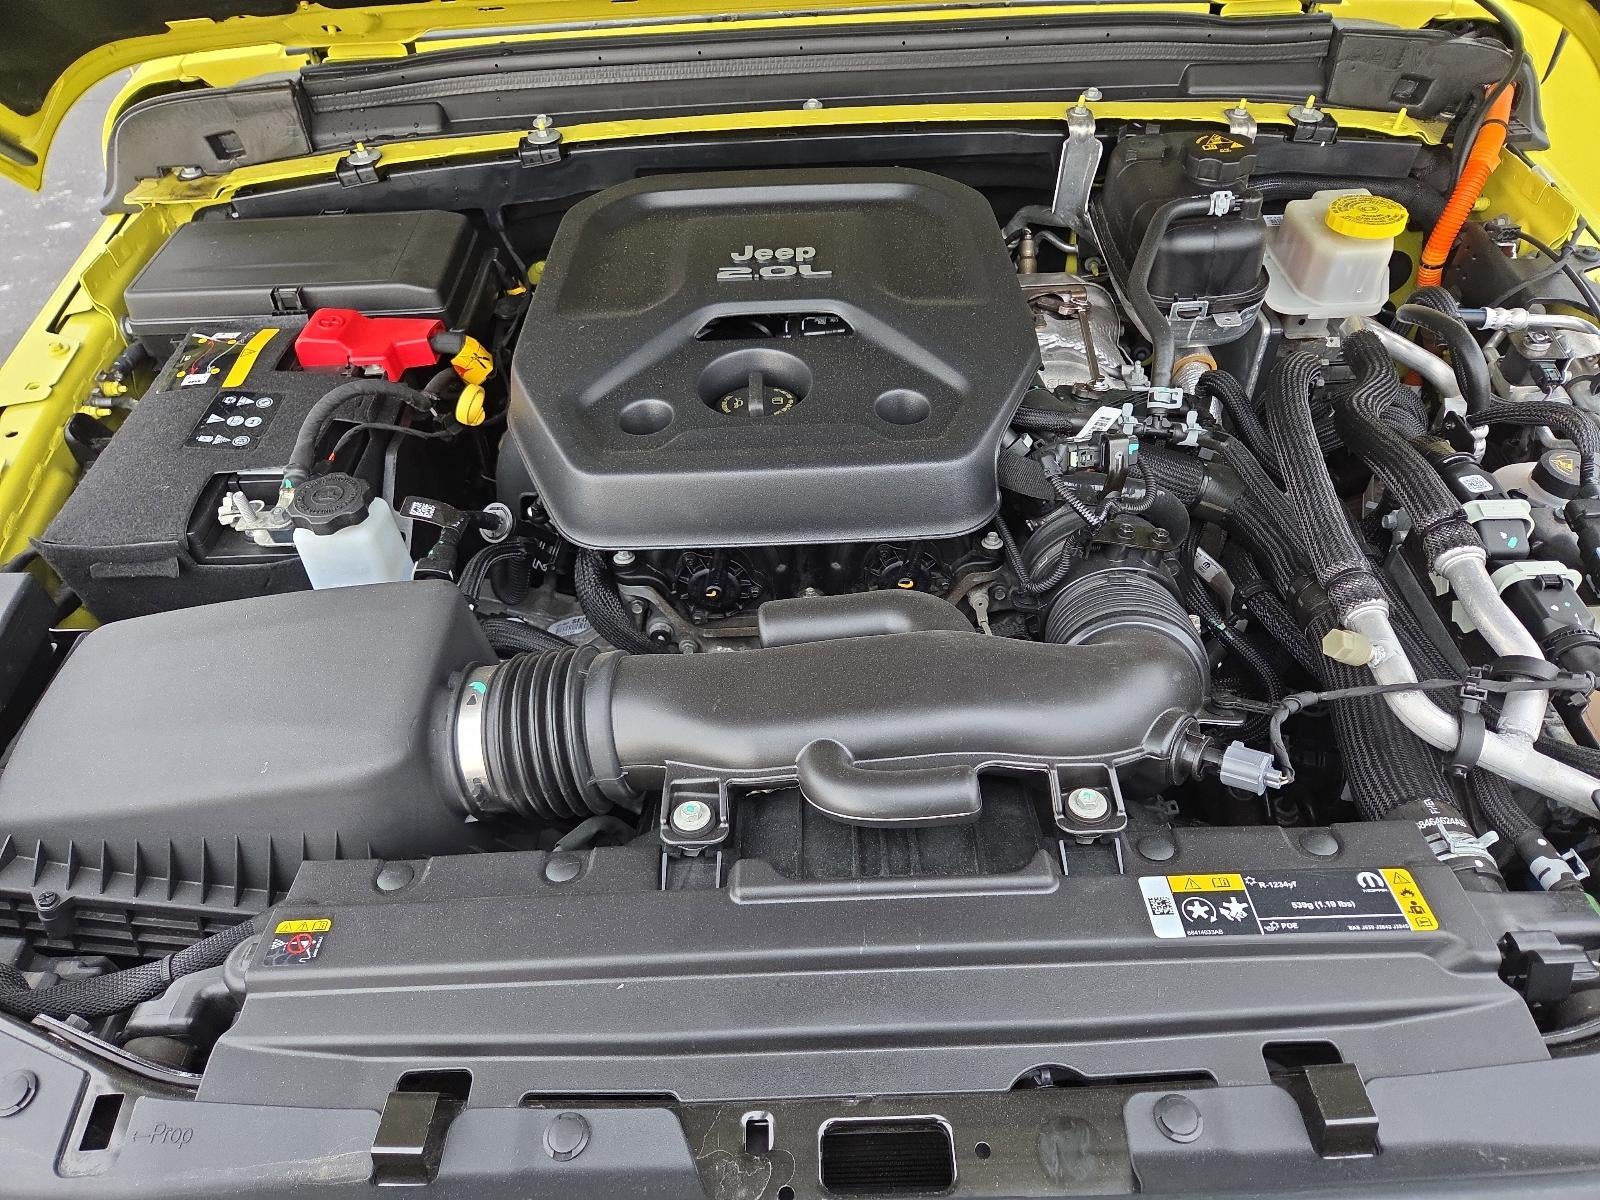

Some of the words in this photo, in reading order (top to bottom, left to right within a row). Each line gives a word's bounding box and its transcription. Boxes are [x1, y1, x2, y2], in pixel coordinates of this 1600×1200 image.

[730, 245, 816, 263] Jeep
[716, 264, 833, 281] 2.0L
[149, 1121, 194, 1150] Prop
